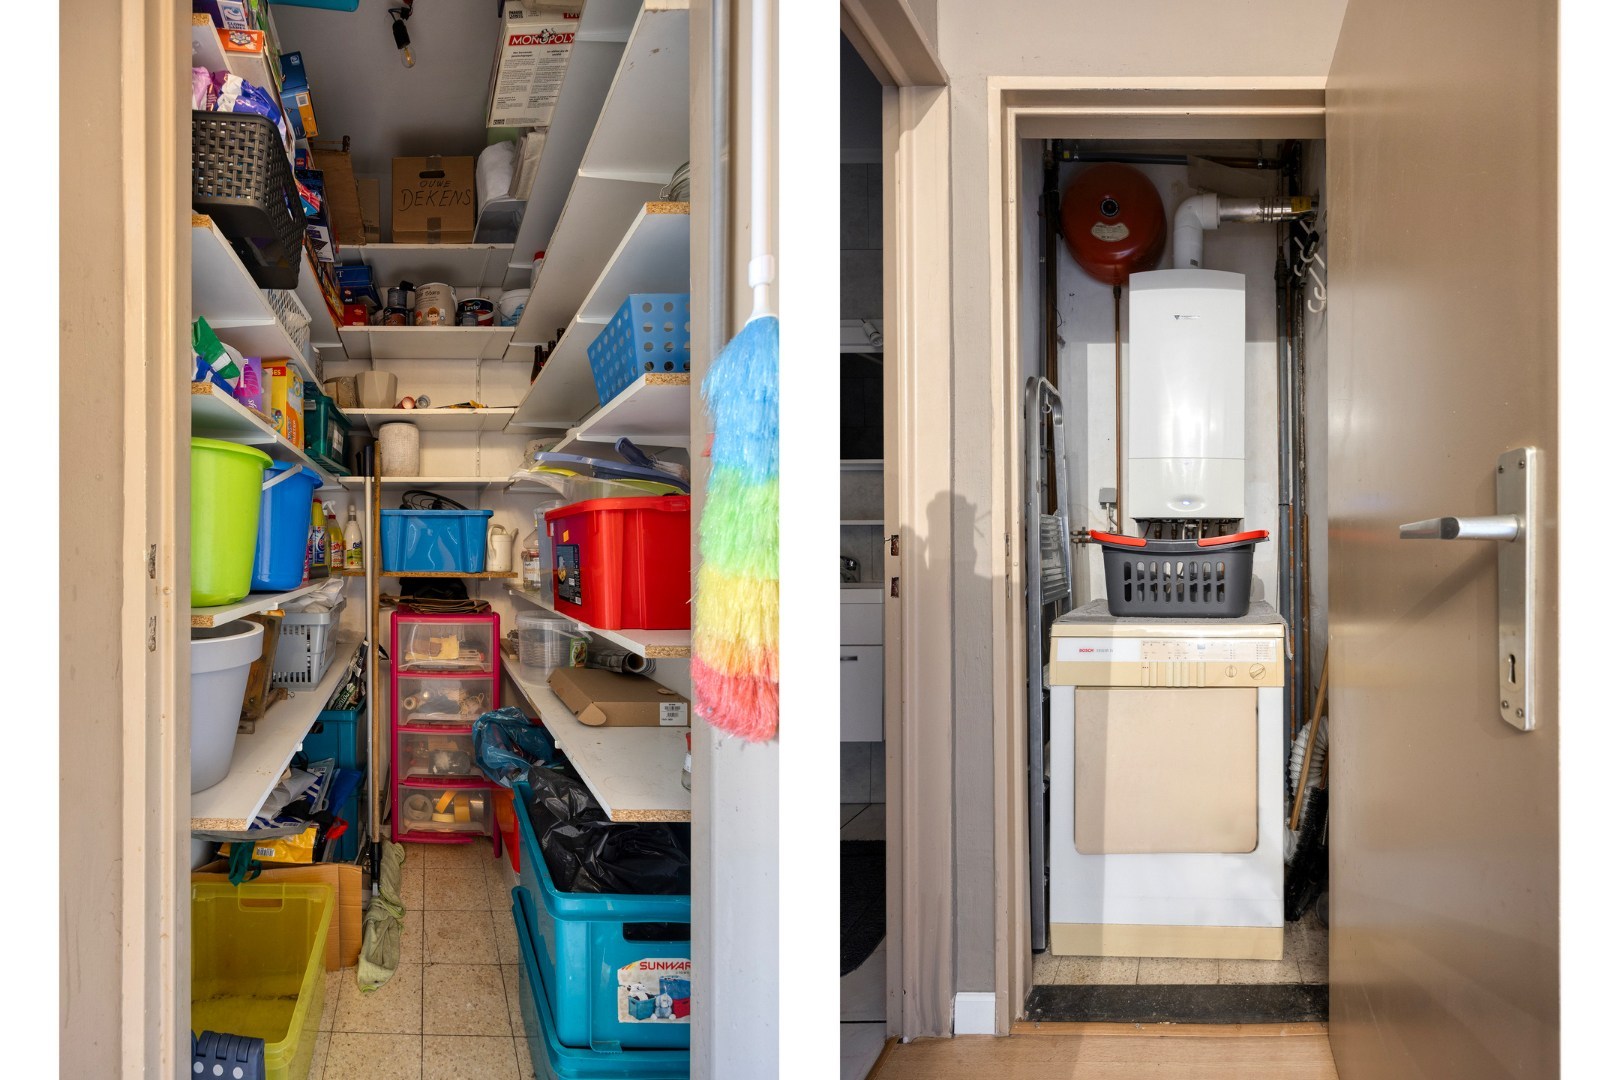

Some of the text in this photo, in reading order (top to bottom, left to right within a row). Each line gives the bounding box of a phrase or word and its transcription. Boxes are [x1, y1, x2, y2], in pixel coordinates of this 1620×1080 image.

[511, 33, 575, 45] MONOPOLY
[420, 180, 452, 188] OUWE
[399, 188, 471, 212] DEKENS
